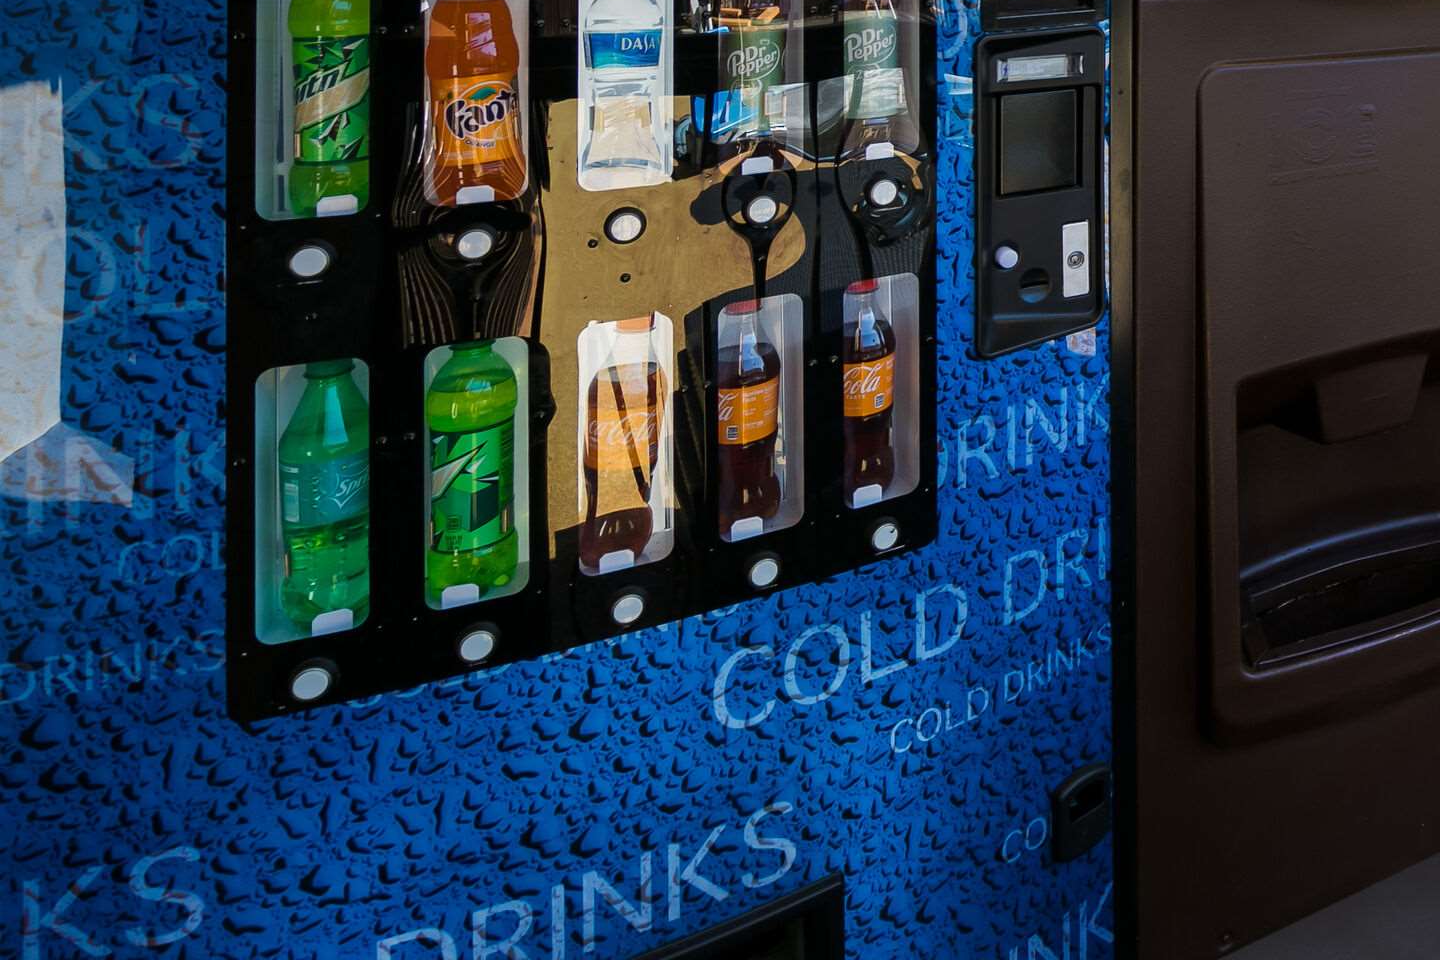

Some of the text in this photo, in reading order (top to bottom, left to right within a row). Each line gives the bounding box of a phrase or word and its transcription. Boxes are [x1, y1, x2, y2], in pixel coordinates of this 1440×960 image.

[844, 33, 895, 63] Pepper
[862, 28, 884, 46] Dr
[727, 50, 777, 78] Pepper
[745, 46, 767, 61] Dr
[713, 581, 968, 730] COLD
[889, 622, 1112, 754] COLD DRINKS
